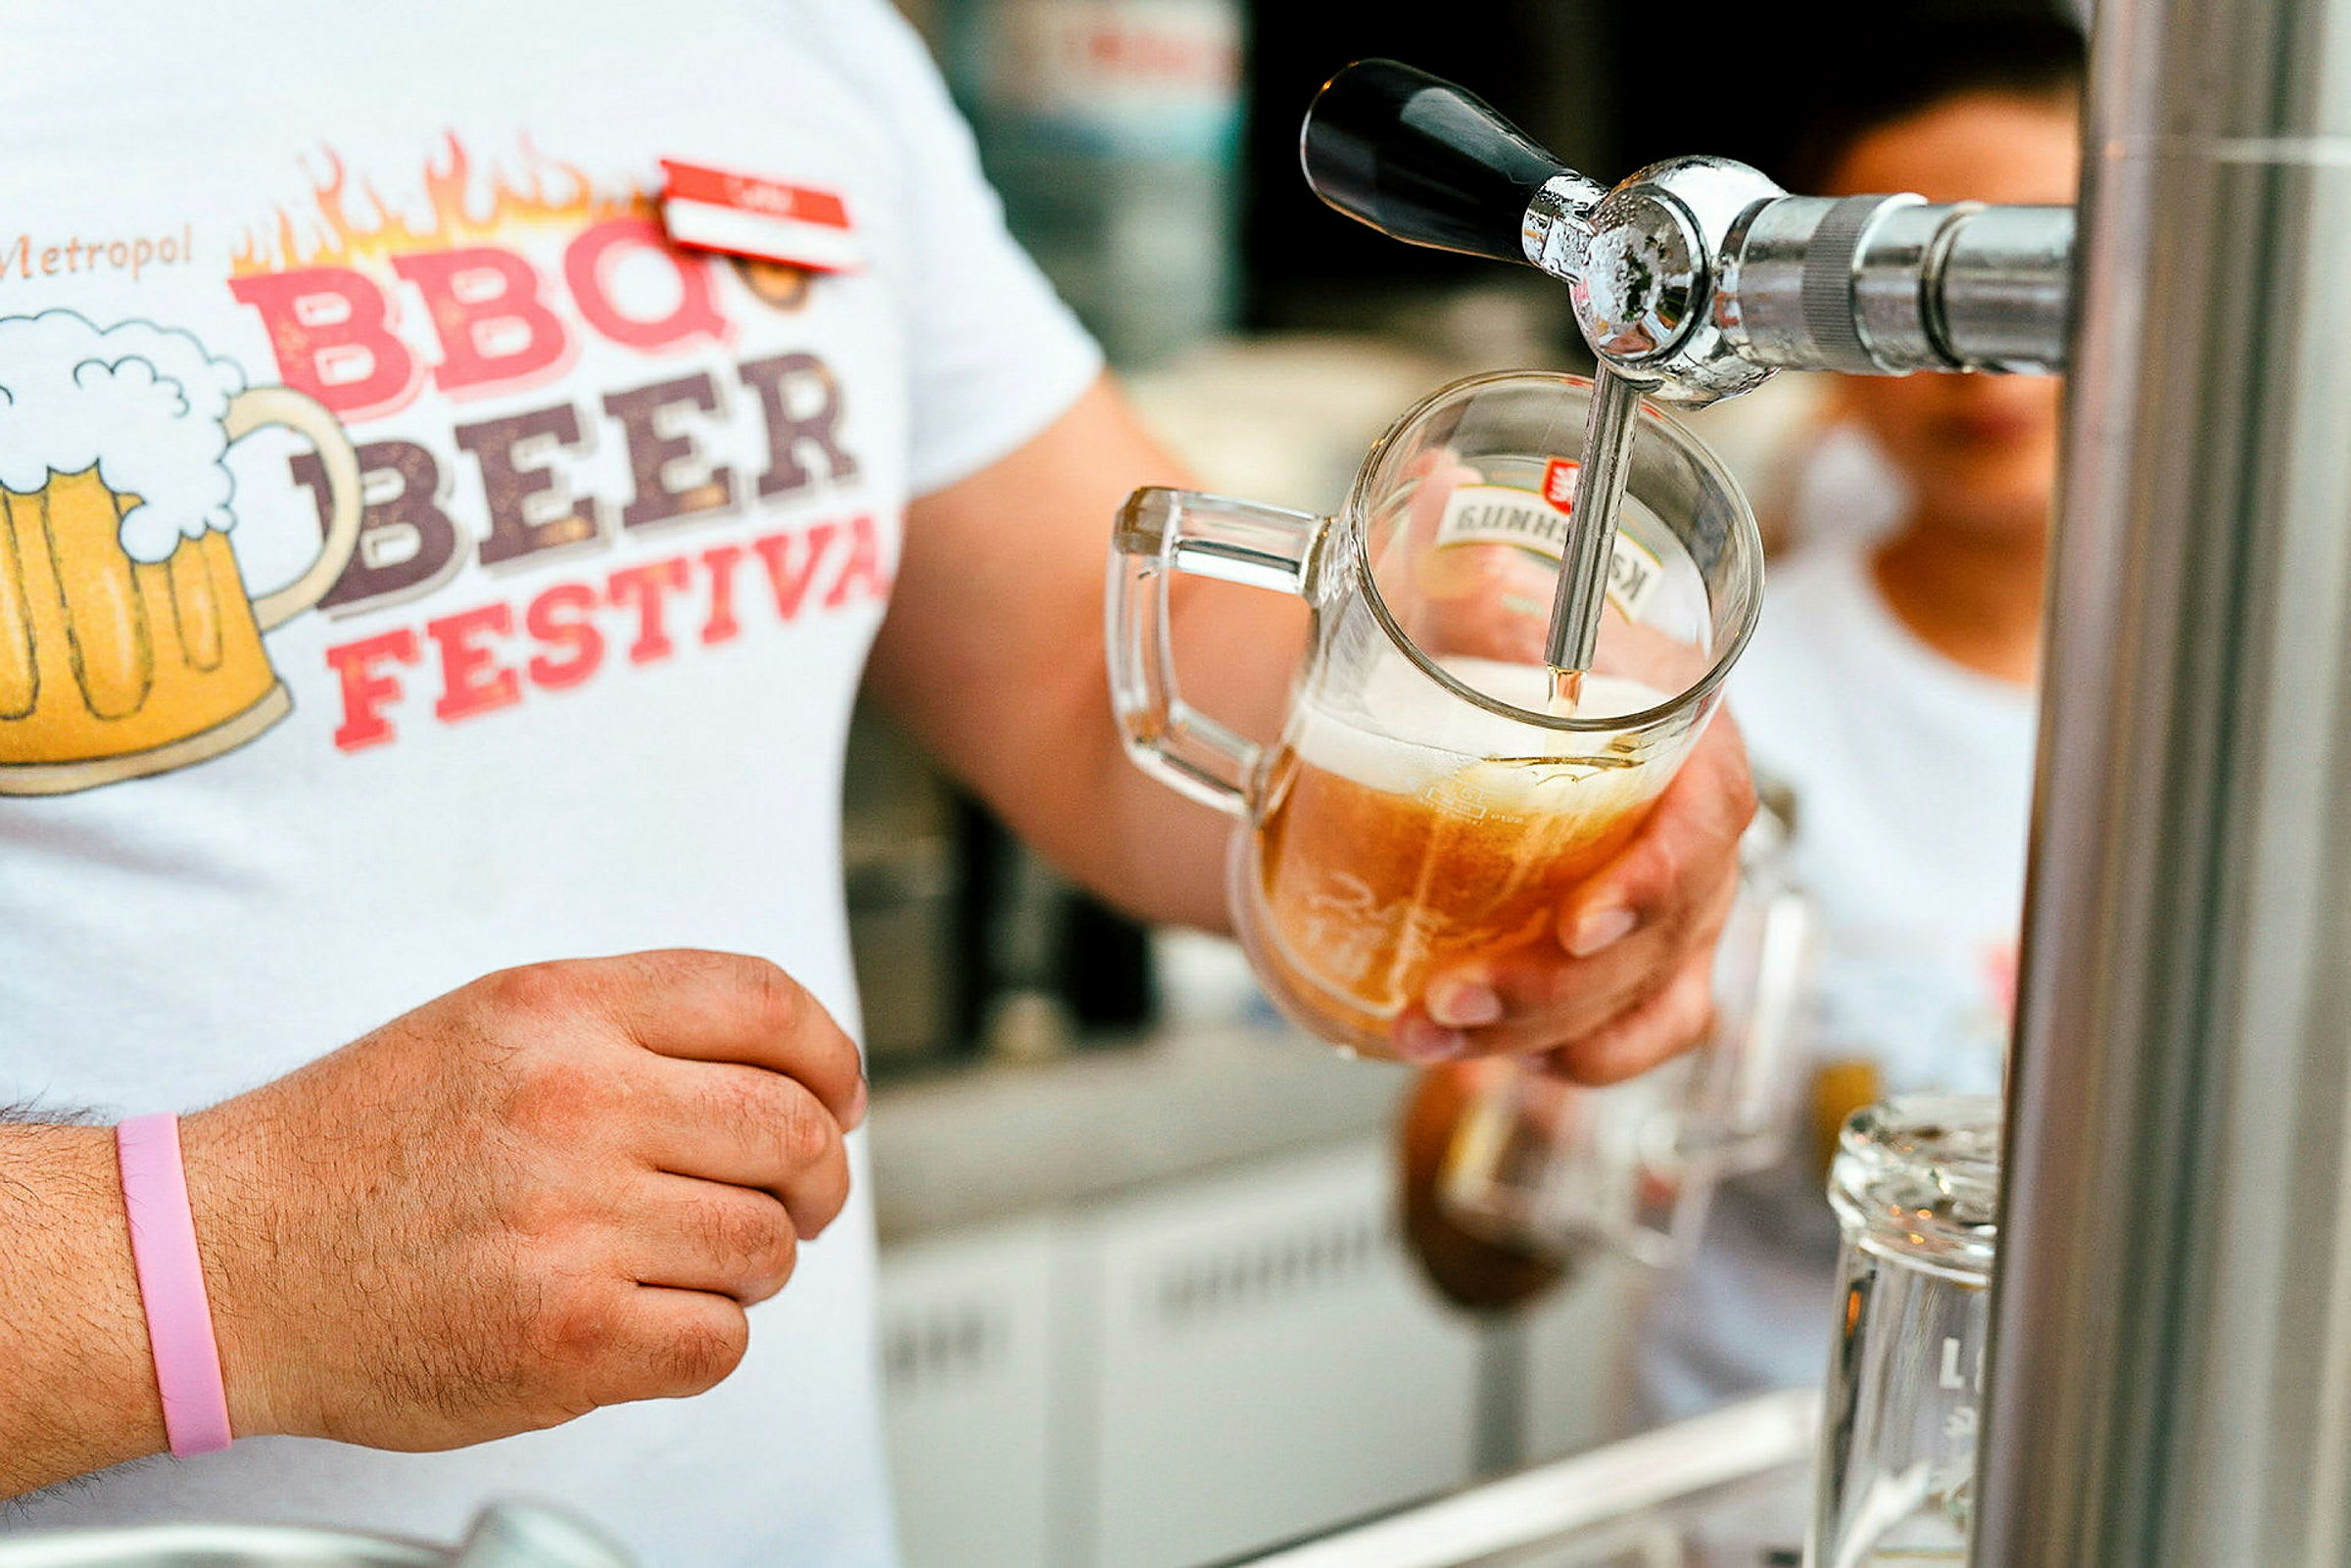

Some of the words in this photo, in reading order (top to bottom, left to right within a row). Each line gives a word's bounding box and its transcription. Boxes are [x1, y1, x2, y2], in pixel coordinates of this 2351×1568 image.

[227, 217, 740, 425] BBQ
[289, 351, 861, 621] BEER
[325, 511, 893, 754] FESTIVA
